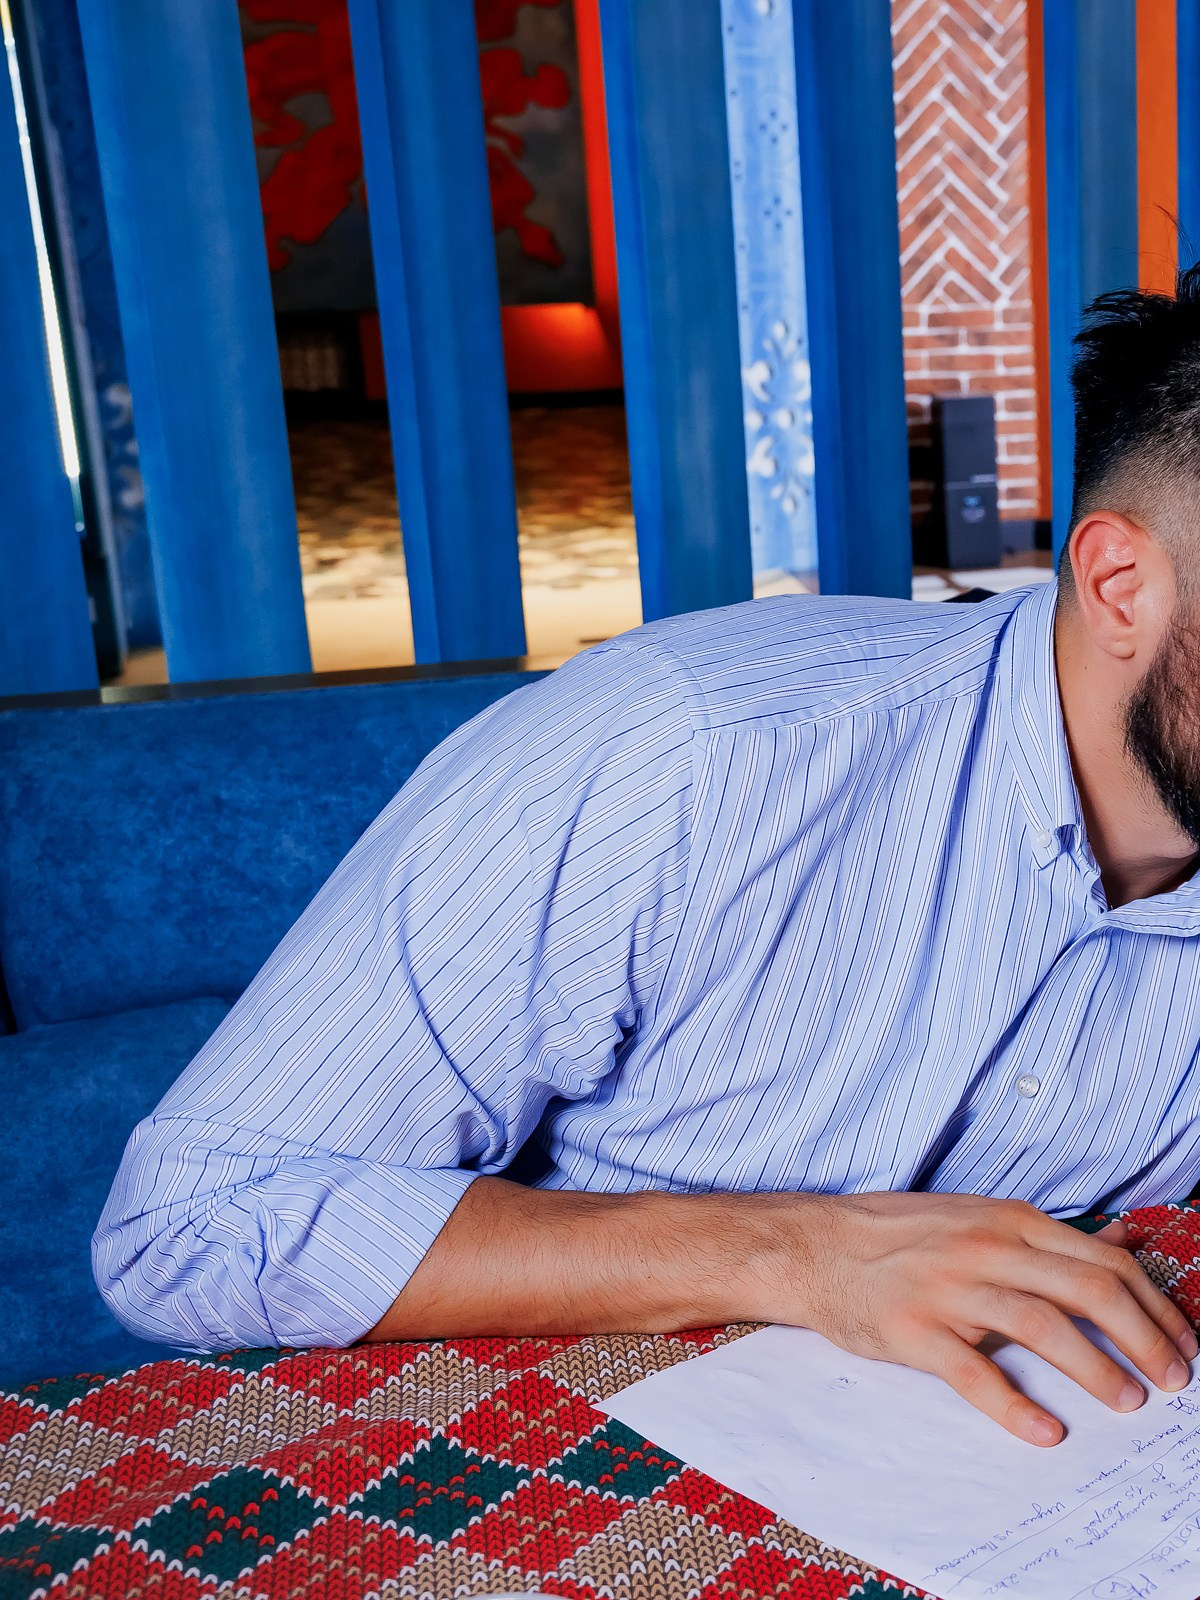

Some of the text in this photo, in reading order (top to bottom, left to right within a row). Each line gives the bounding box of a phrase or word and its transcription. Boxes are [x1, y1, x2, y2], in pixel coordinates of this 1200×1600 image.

[1164, 1390, 1192, 1411] VI
[1150, 1462, 1166, 1483] до
[1124, 1484, 1142, 1500] 1,5
[1018, 1501, 1066, 1527] Индия
[1082, 1500, 1122, 1535] метров
[920, 1540, 998, 1581] Пакистан
